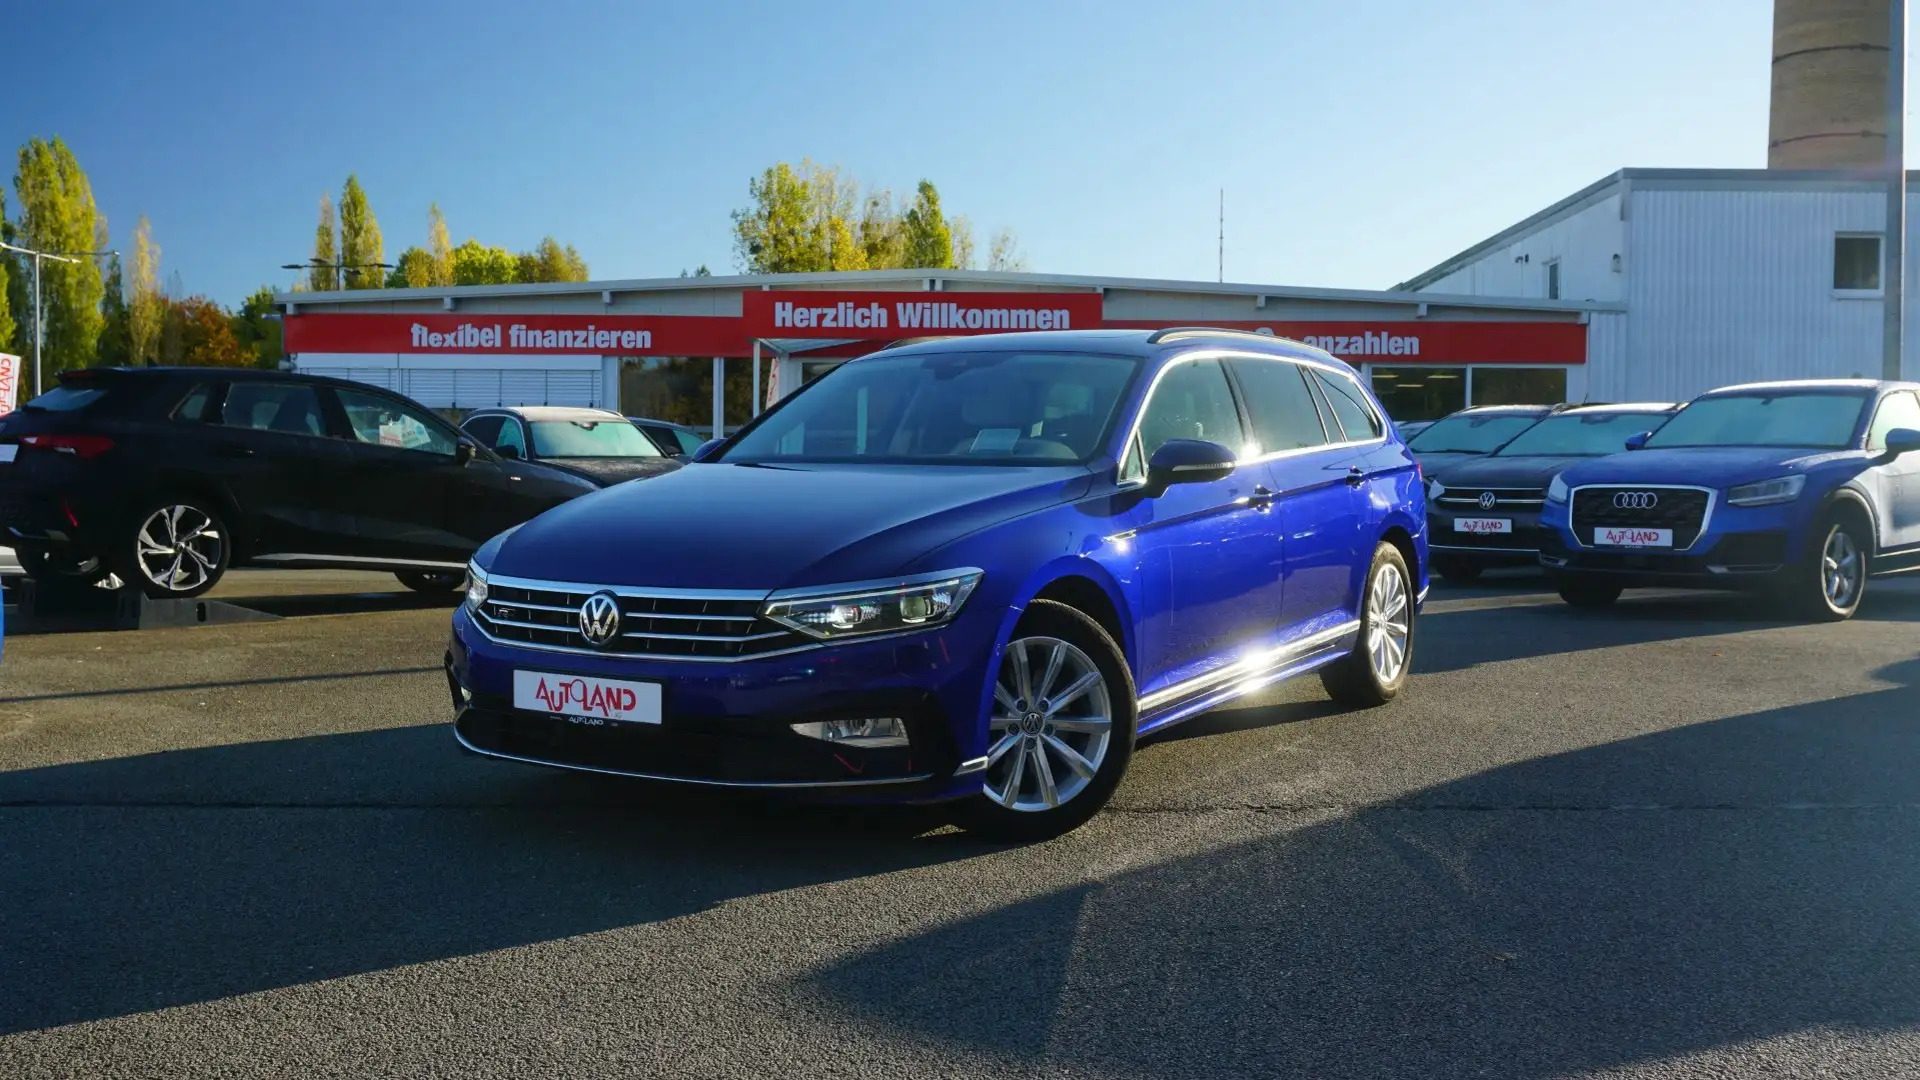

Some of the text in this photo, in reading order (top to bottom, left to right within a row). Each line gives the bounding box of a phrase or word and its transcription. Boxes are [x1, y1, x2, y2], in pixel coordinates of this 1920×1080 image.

[774, 302, 1070, 329] Herzlich Willkommen
[411, 323, 652, 348] flexibel finanzieren
[535, 677, 637, 717] AUTOLAND
